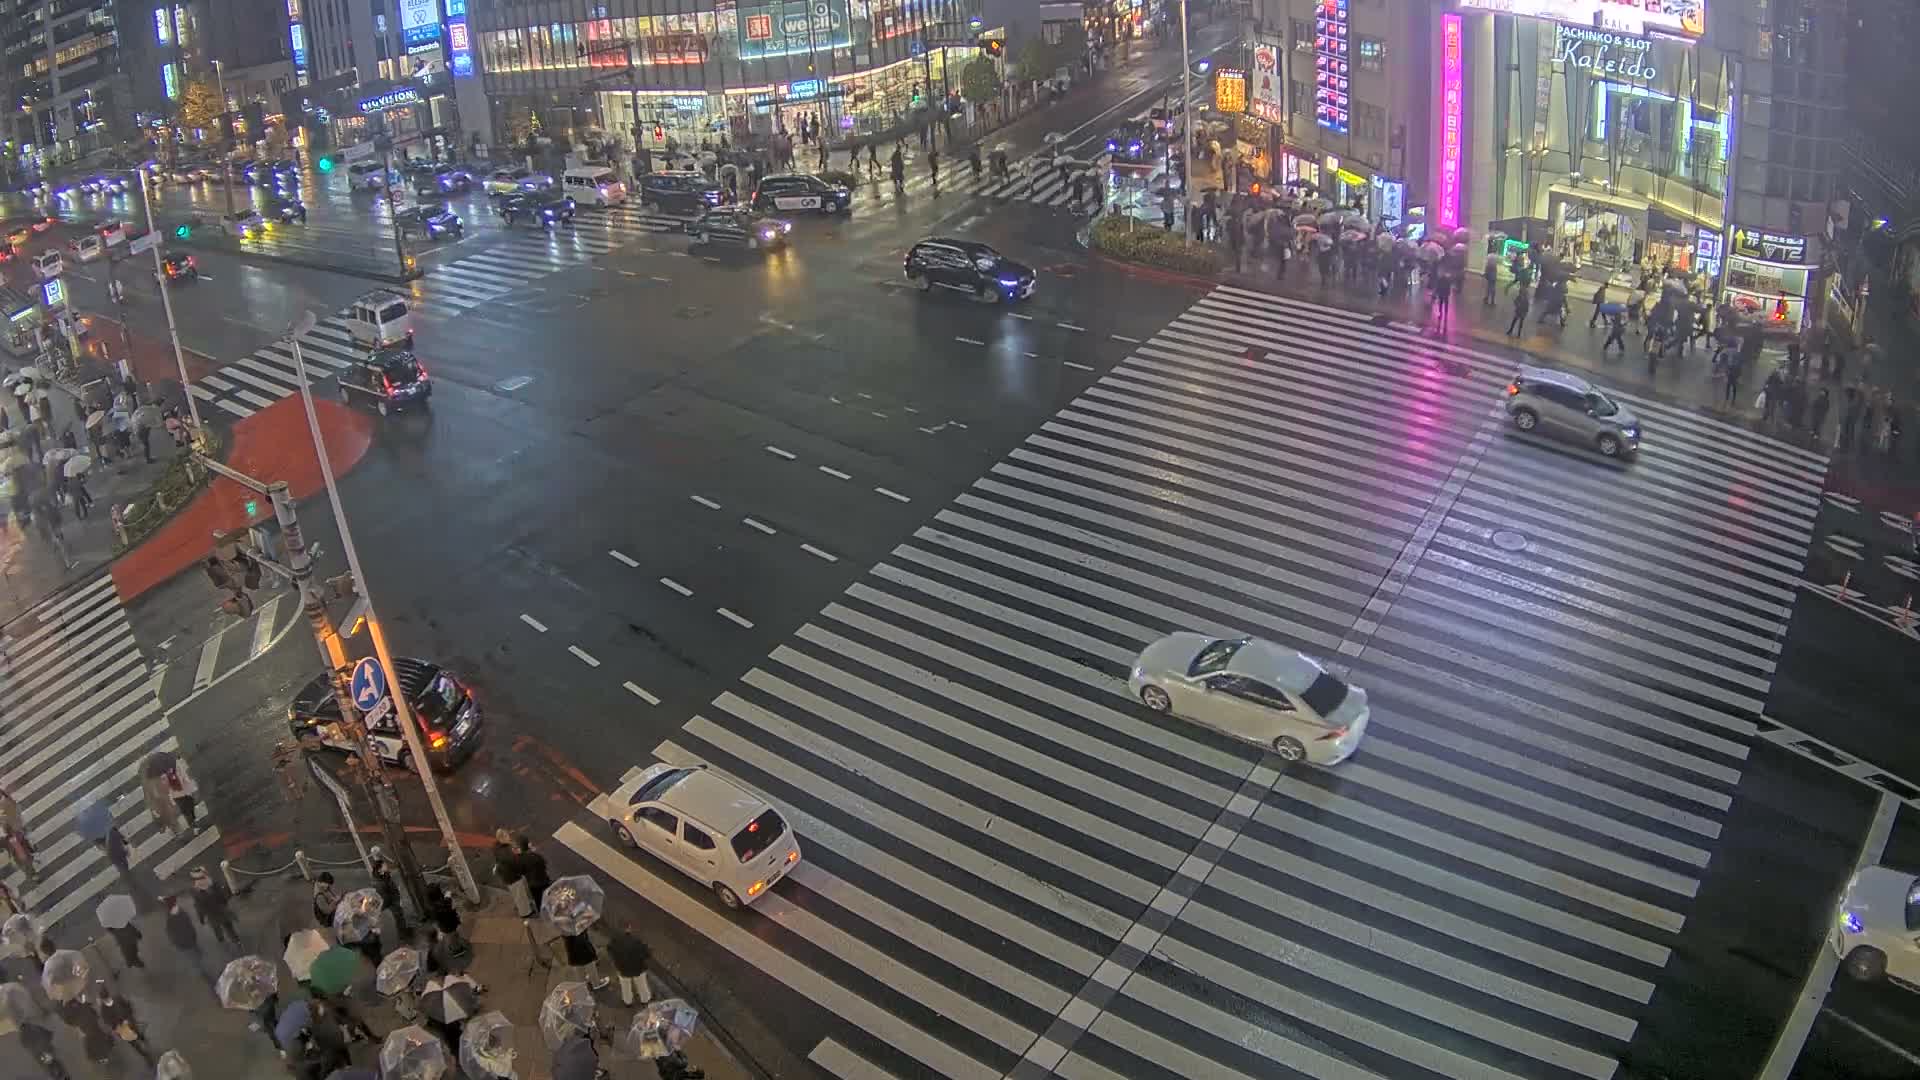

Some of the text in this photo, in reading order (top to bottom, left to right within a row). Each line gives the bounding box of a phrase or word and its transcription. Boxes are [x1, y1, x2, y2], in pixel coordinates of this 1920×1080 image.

[1556, 25, 1612, 44] PACHINKO
[1614, 35, 1622, 45] &
[1624, 37, 1652, 52] SLOT
[1551, 37, 1656, 80] Kaleido
